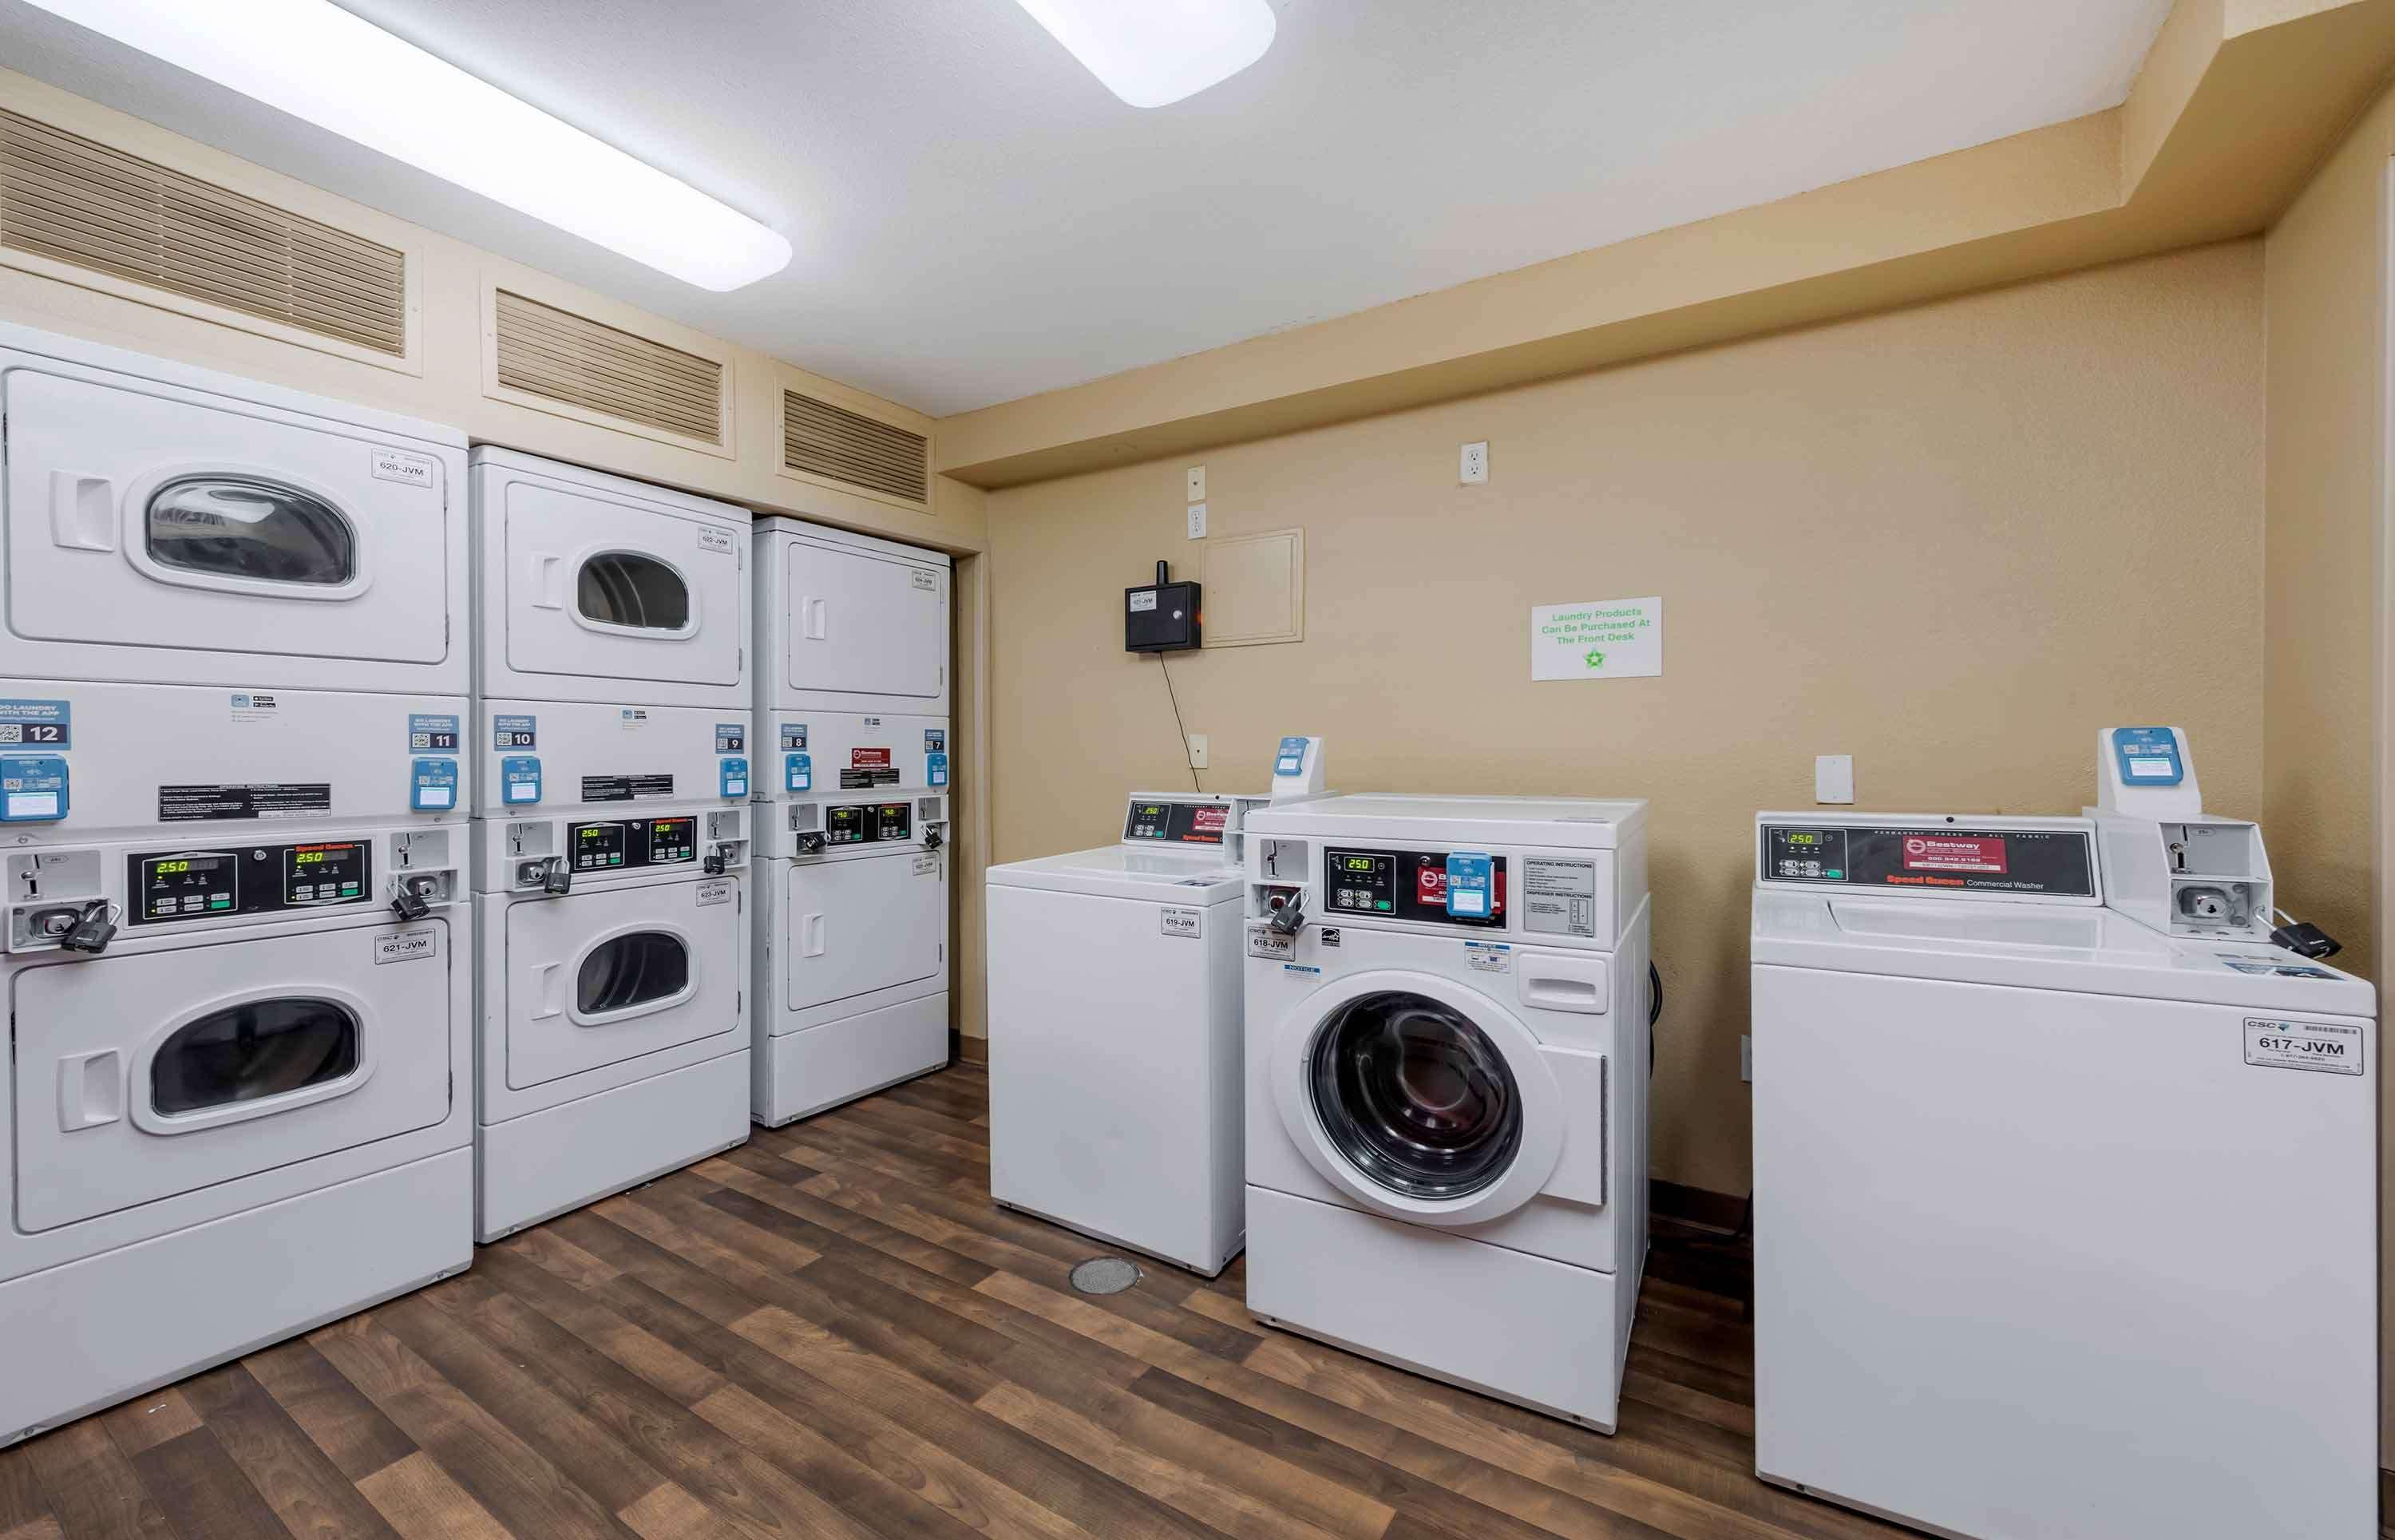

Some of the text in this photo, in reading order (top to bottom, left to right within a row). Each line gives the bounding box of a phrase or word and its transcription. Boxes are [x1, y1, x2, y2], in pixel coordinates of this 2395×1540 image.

[379, 461, 423, 476] 620-JVM
[1552, 608, 1642, 621] Laundry Products
[1542, 619, 1652, 634] Can Be Purchased At
[1557, 631, 1635, 645] The Front Desk
[30, 726, 58, 741] 12
[515, 734, 531, 745] 10
[436, 734, 450, 746] 11
[731, 739, 739, 748] 9
[795, 738, 802, 746] 8
[1926, 841, 1980, 850] Bestway
[1886, 874, 1924, 884] Speed
[1926, 875, 1965, 885] Queen
[1966, 879, 2013, 888] Commercial
[1166, 918, 1195, 927] 619-JVM
[383, 940, 427, 952] 621-JVM
[1254, 938, 1289, 949] 618-JVM
[2247, 1020, 2276, 1029] CSC
[2259, 1037, 2345, 1055] 617-JVM
